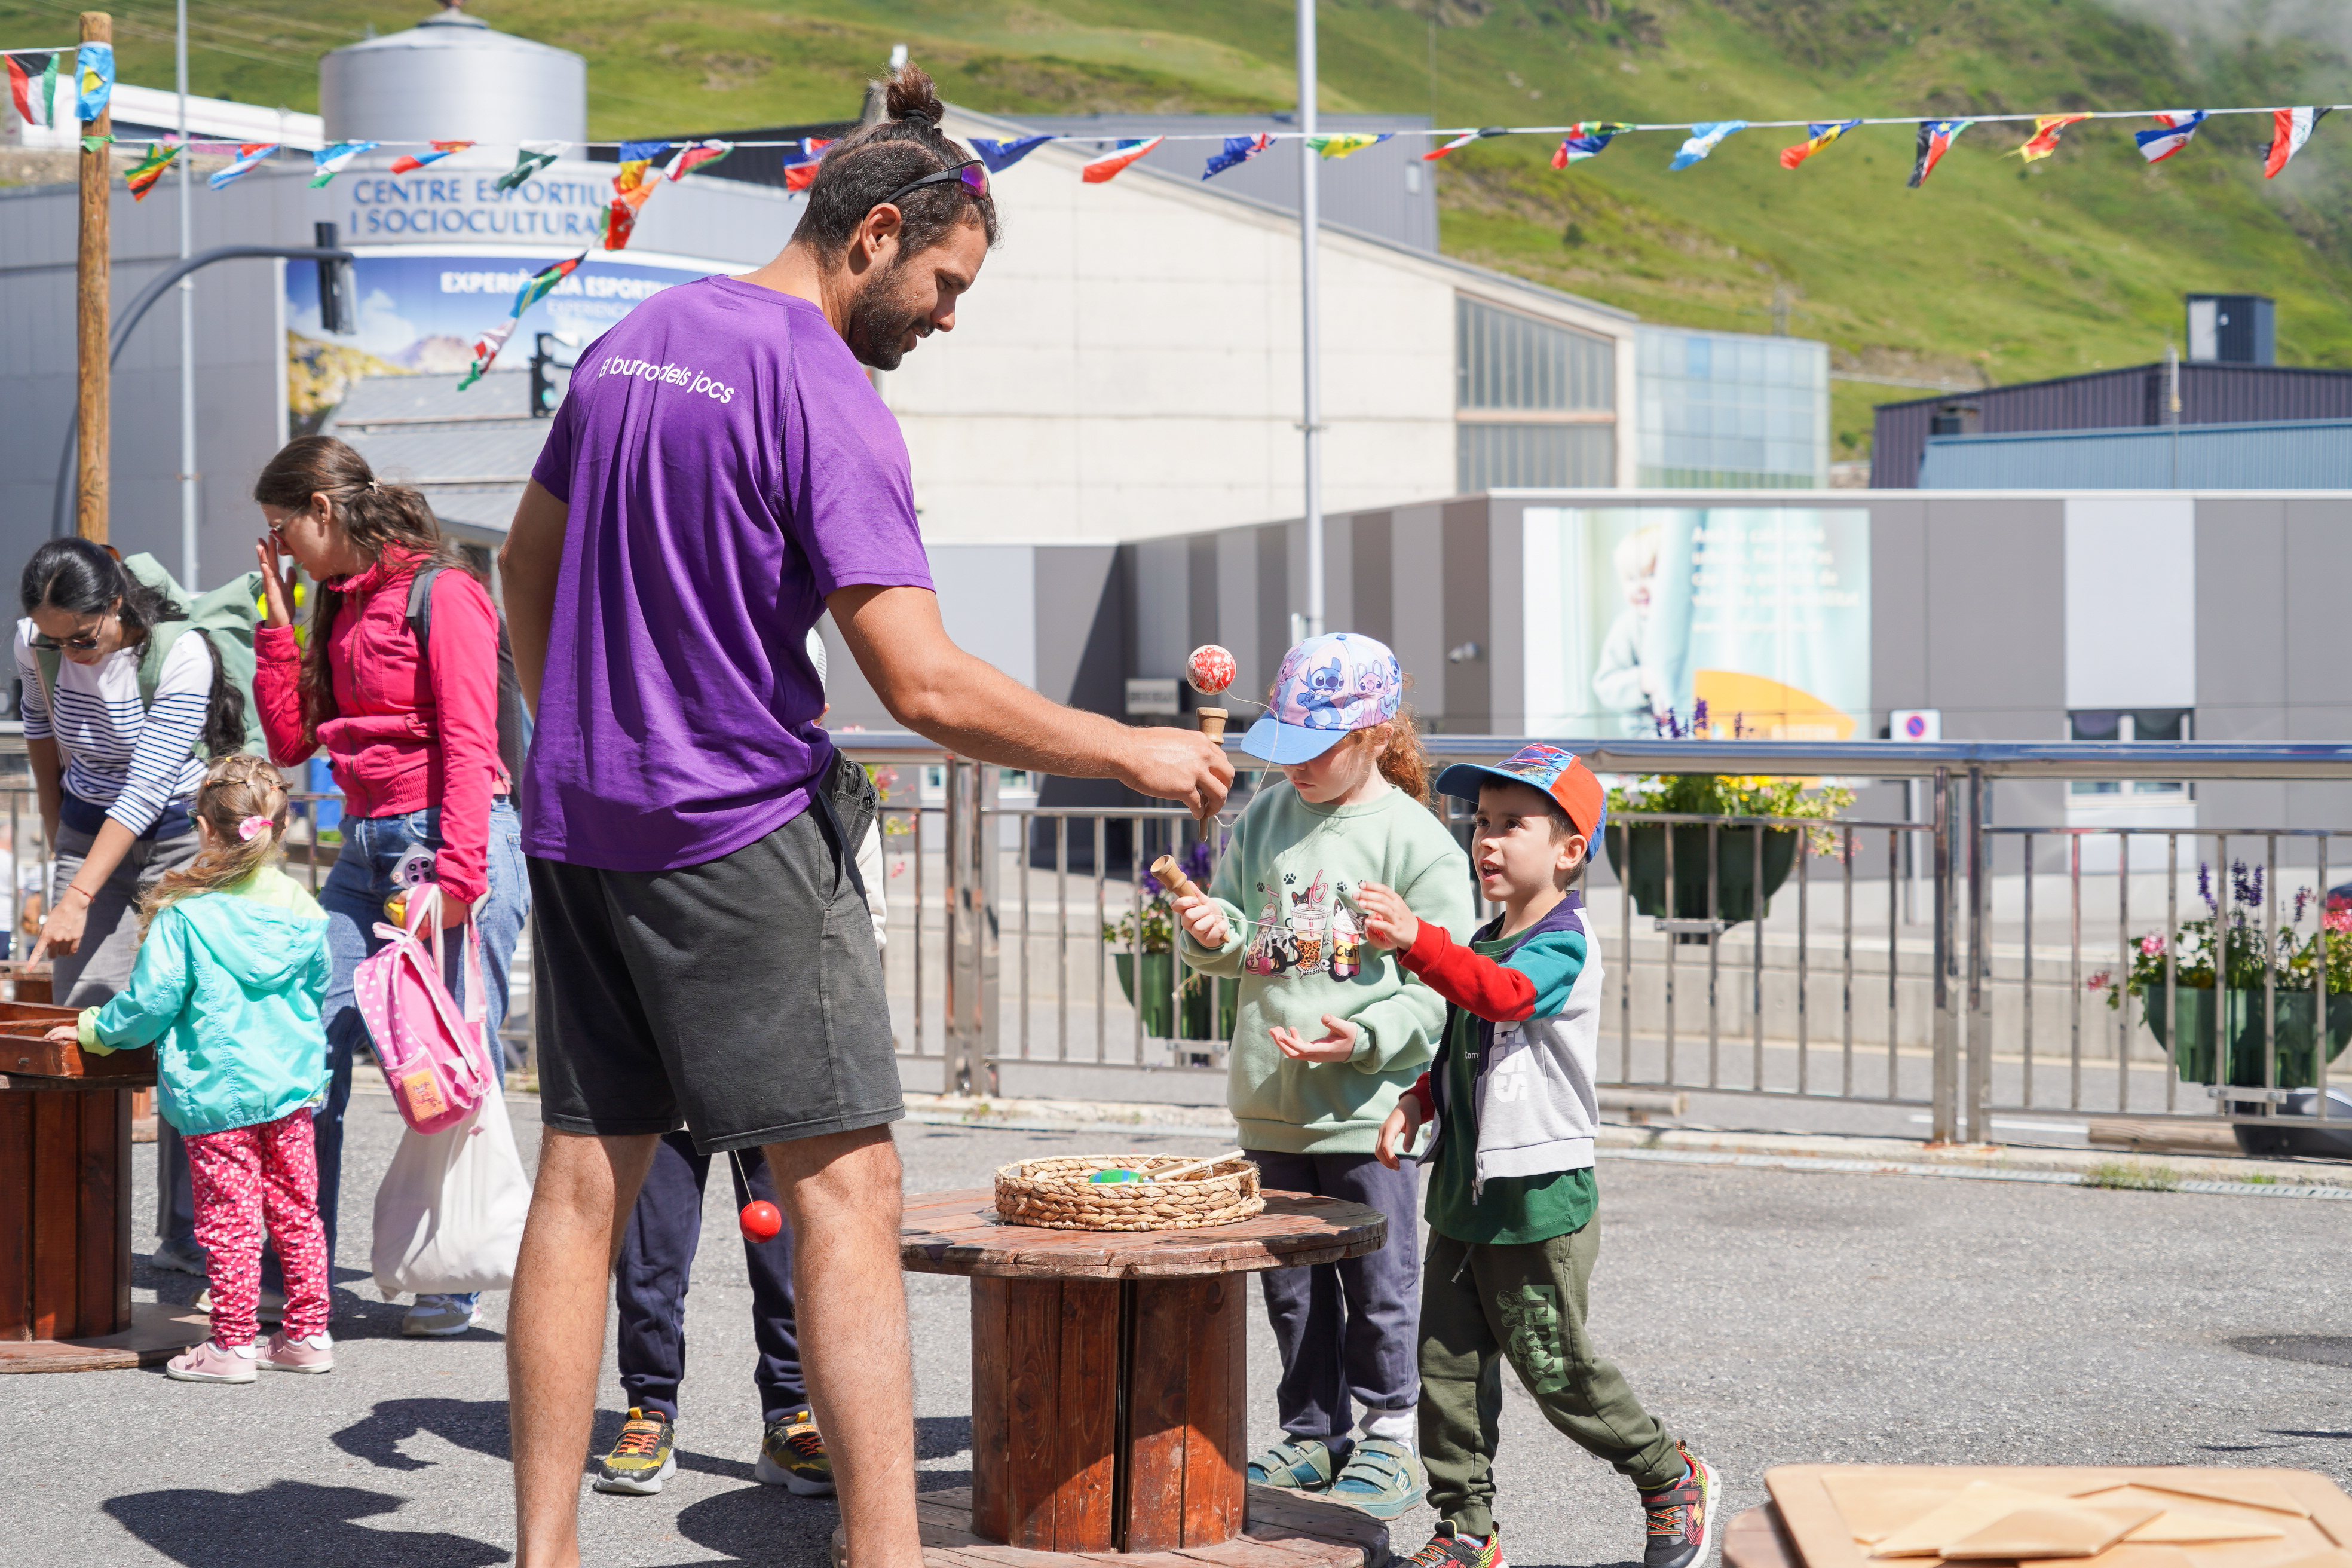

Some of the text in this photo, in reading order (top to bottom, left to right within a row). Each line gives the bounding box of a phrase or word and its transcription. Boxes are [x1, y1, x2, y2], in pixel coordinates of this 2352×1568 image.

[353, 178, 461, 205] CENTRE
[350, 209, 601, 235] I SOCIOCULTURA
[686, 370, 735, 403] jocs
